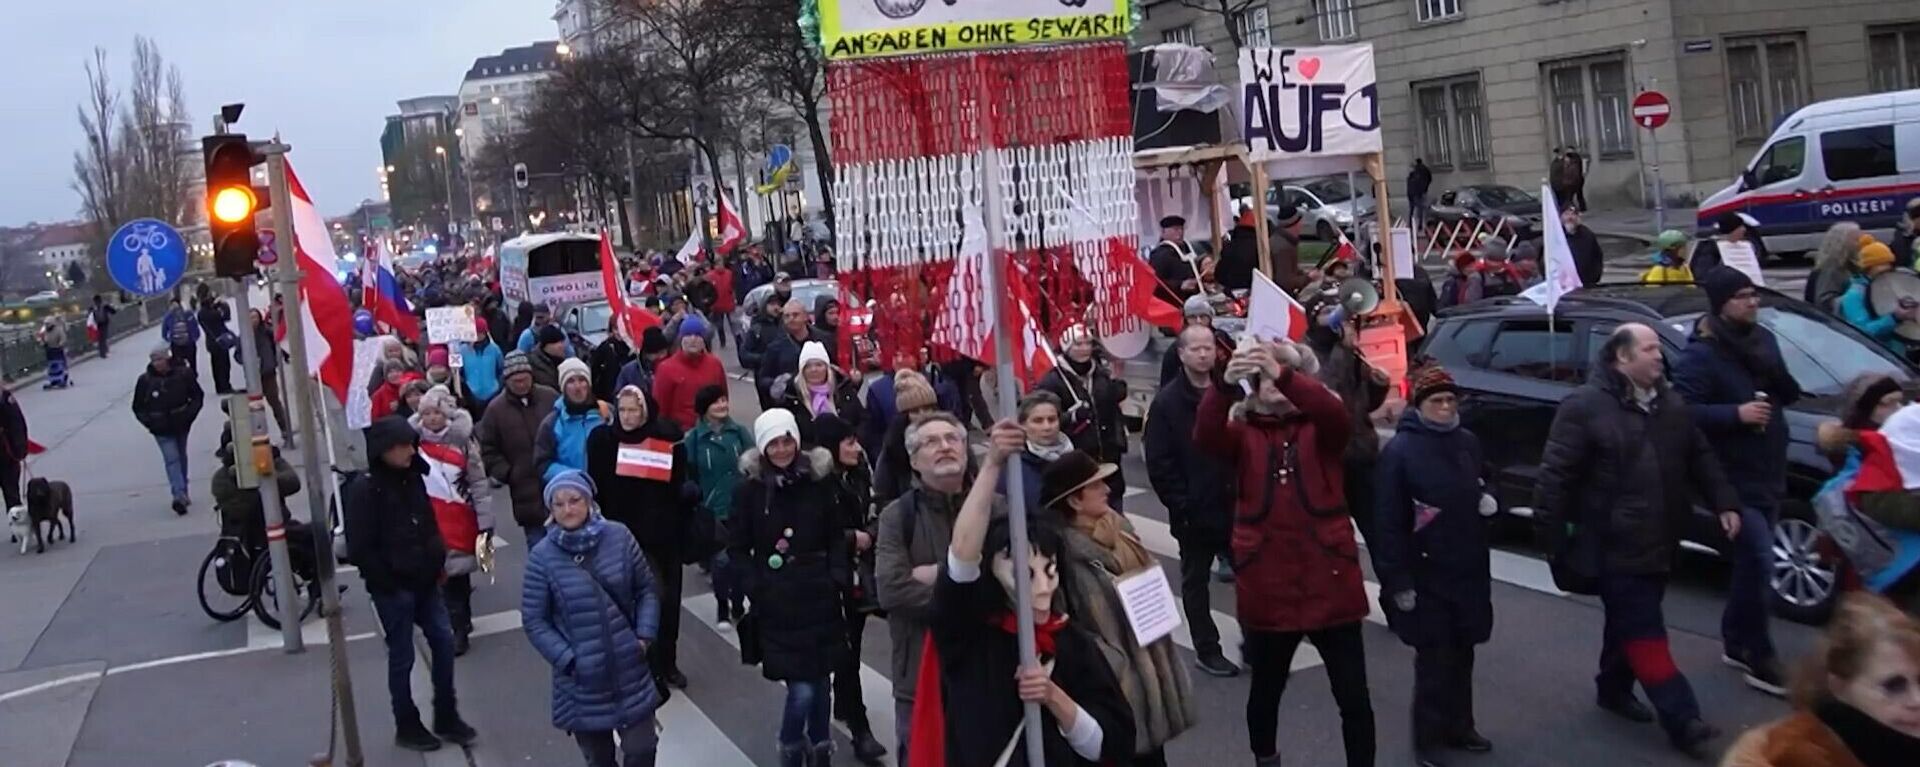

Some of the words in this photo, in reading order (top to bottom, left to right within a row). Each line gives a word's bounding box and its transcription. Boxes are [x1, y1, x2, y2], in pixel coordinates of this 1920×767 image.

[958, 22, 1016, 43] OHNE
[1251, 50, 1296, 89] WE
[1821, 200, 1886, 216] POLIZEI
